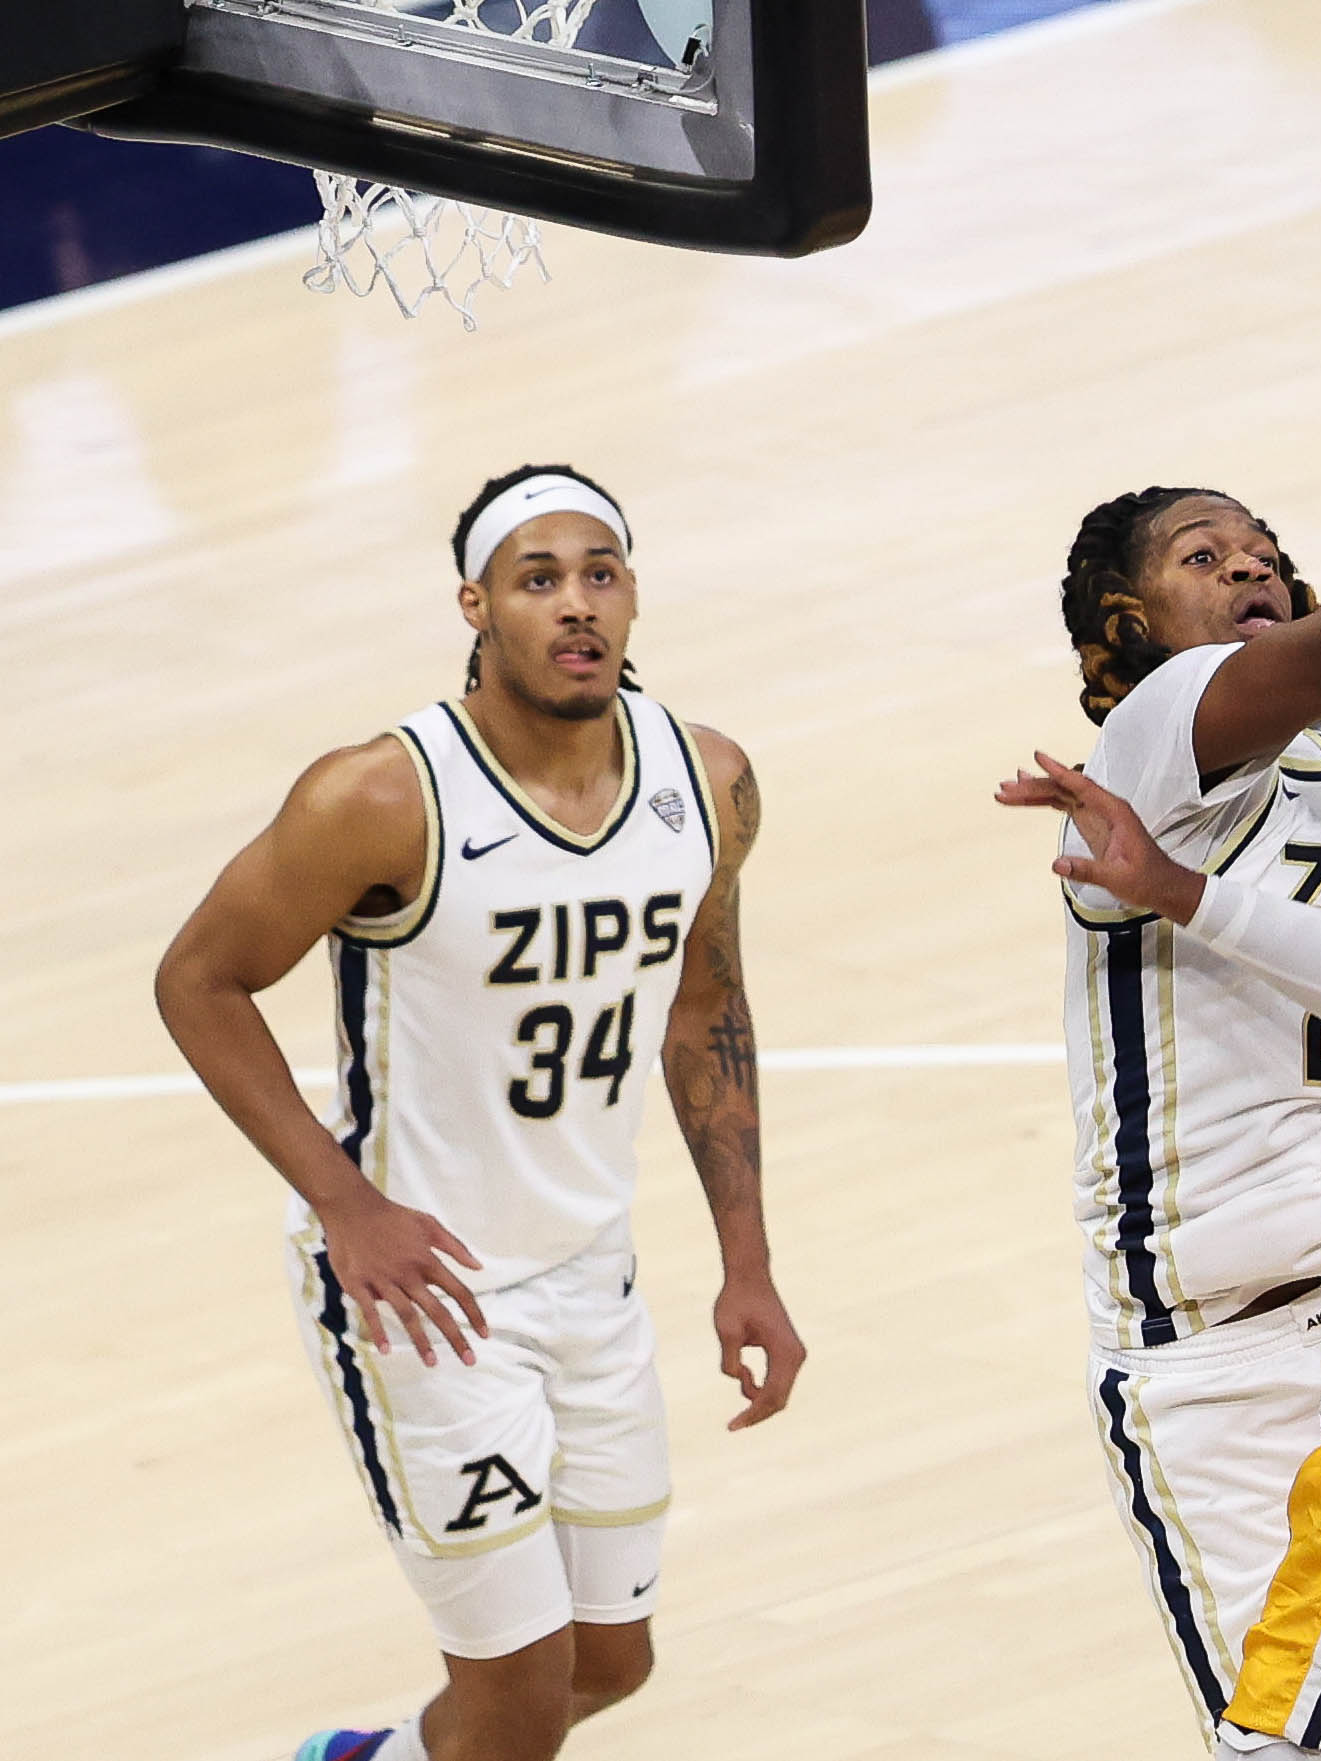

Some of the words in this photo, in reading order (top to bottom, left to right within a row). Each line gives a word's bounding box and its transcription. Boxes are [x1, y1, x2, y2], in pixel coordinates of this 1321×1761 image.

[485, 890, 684, 986] ZIPS
[507, 989, 636, 1120] 34
[444, 1453, 543, 1533] A
